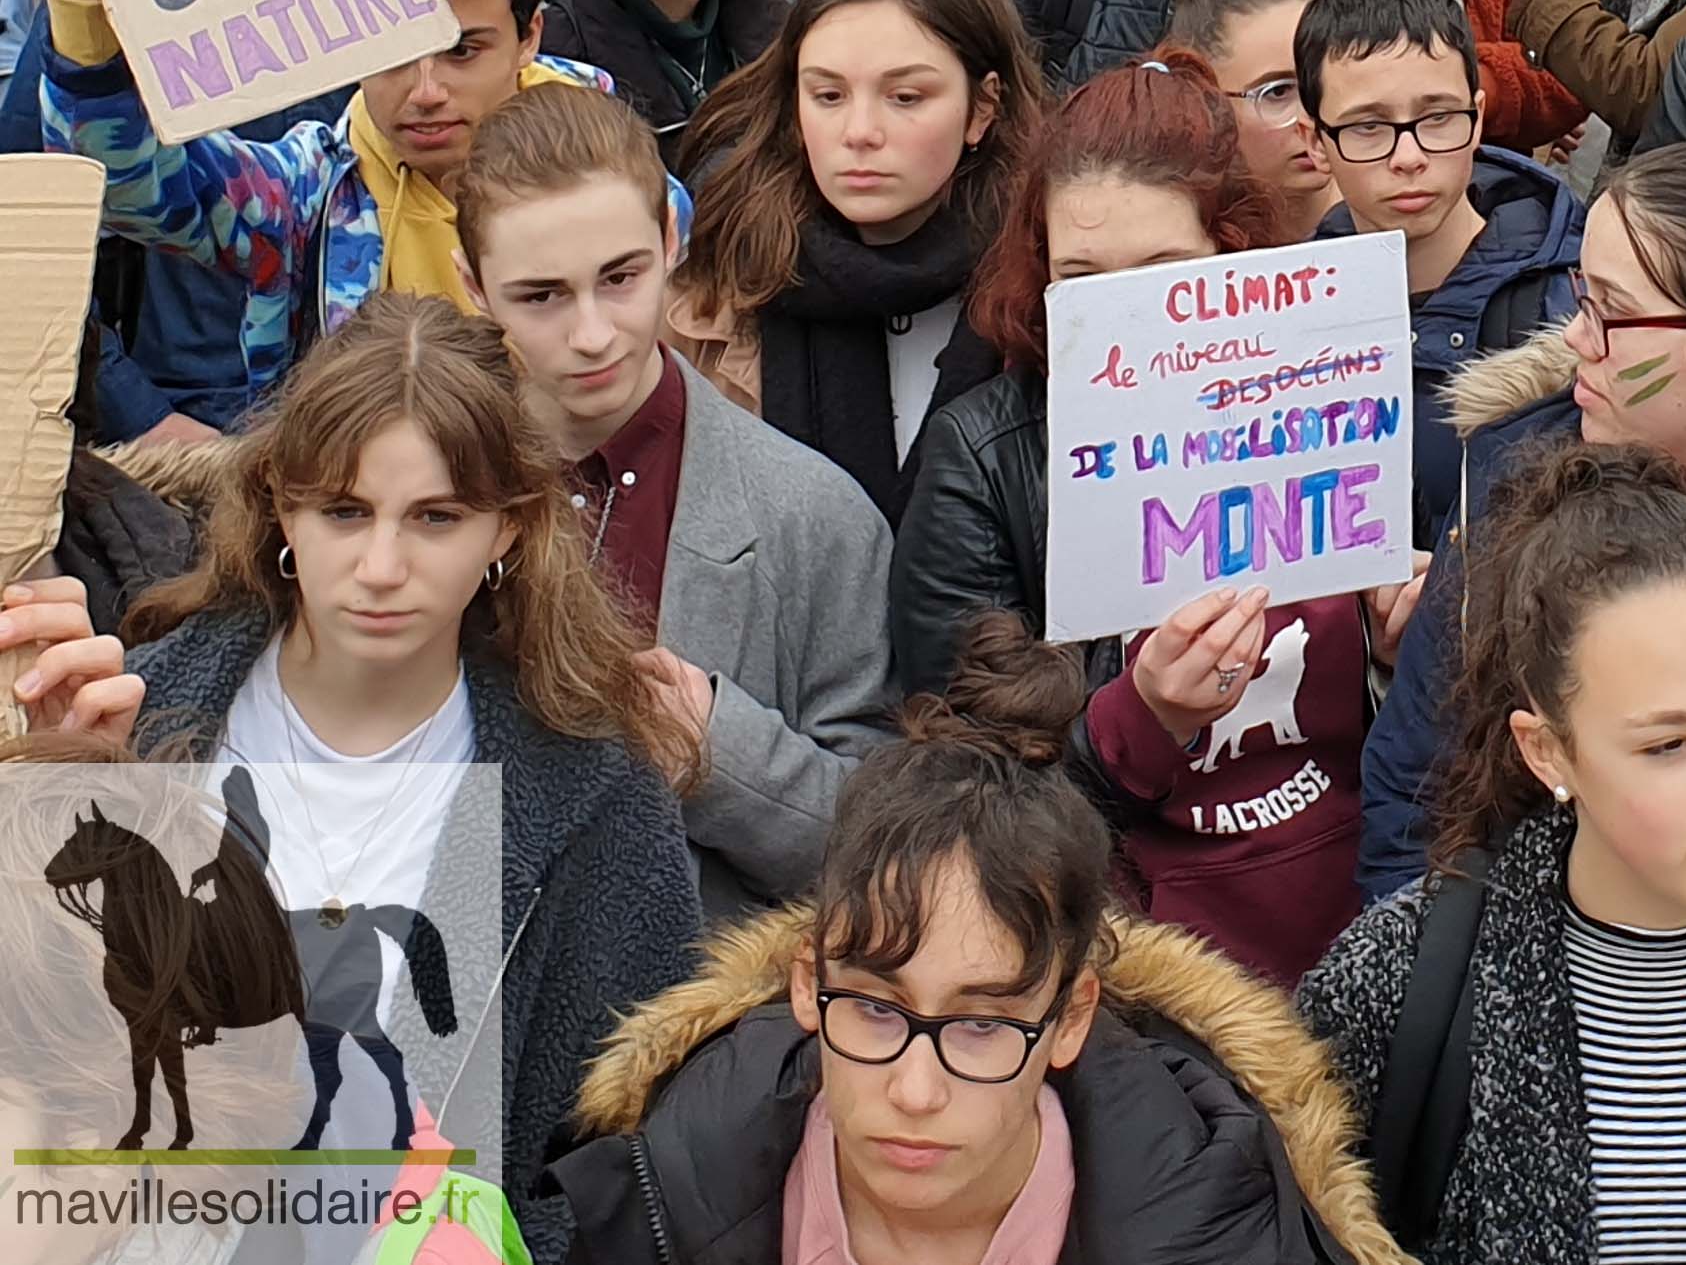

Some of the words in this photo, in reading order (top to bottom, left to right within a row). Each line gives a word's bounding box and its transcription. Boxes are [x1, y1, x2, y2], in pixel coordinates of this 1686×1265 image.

[1090, 344, 1138, 388] le
[1150, 331, 1277, 379] niveau
[1070, 440, 1117, 480] DE
[1133, 433, 1168, 473] LA
[1142, 463, 1385, 585] MONTE
[1191, 759, 1331, 834] LACROSSE
